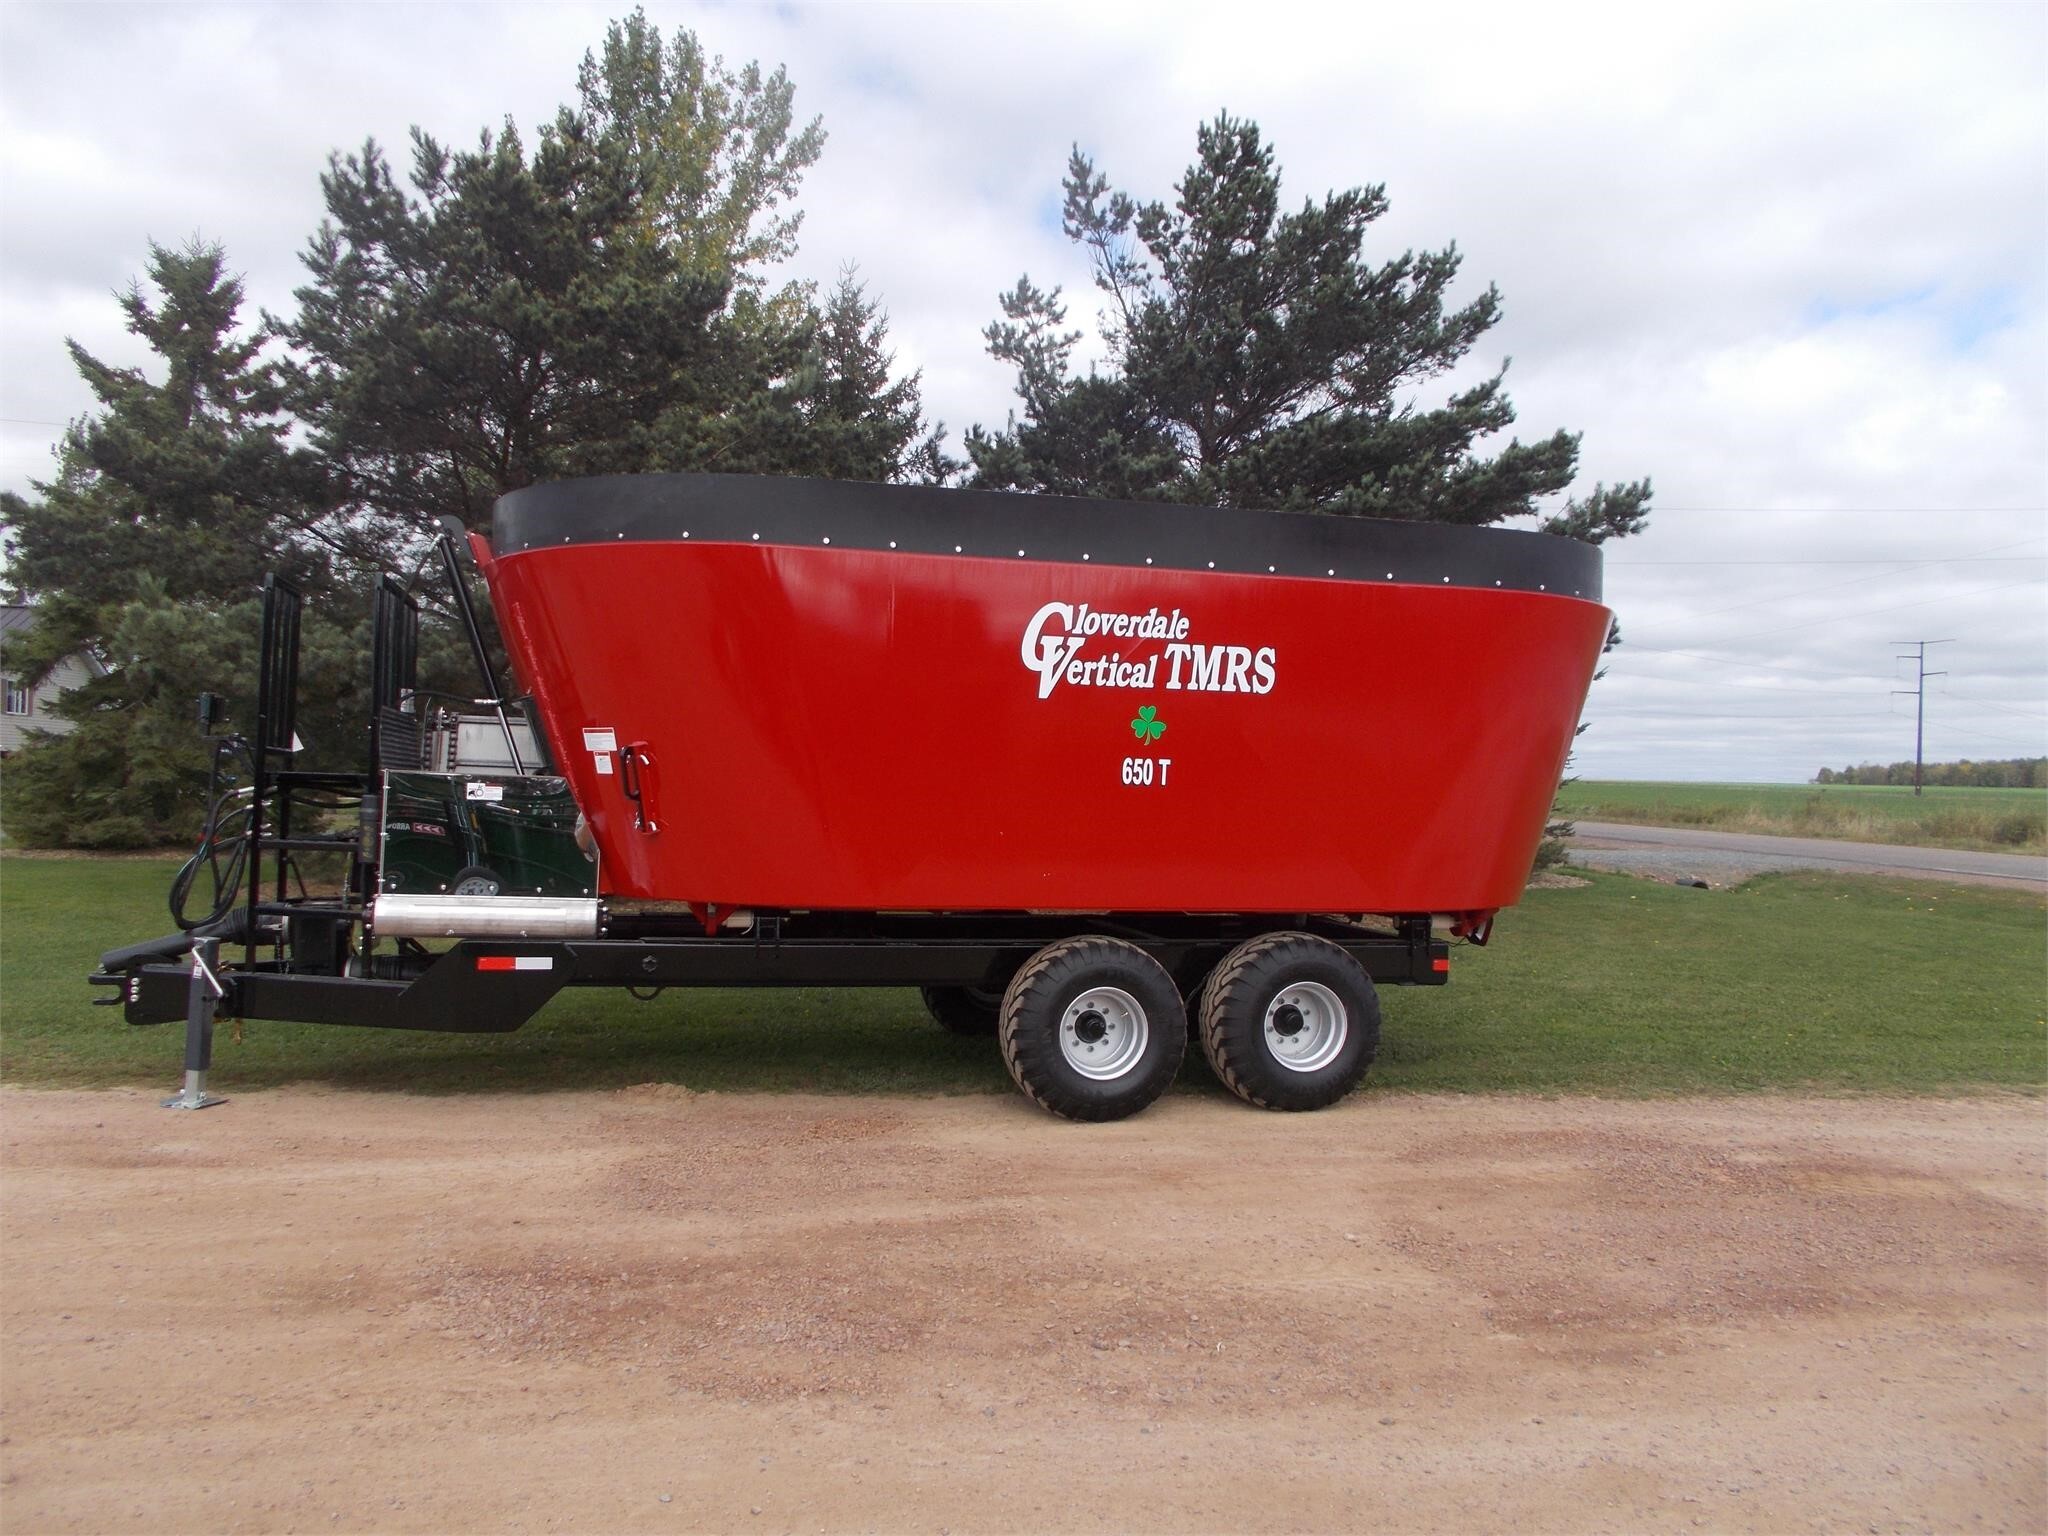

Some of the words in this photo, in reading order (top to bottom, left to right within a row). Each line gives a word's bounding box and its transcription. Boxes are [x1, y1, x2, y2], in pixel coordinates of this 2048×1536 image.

[1021, 601, 1190, 672] Cloverdale
[1038, 635, 1158, 699] Vertical
[1164, 643, 1276, 695] TMRS
[1122, 757, 1153, 786] 650
[1159, 758, 1171, 786] T
